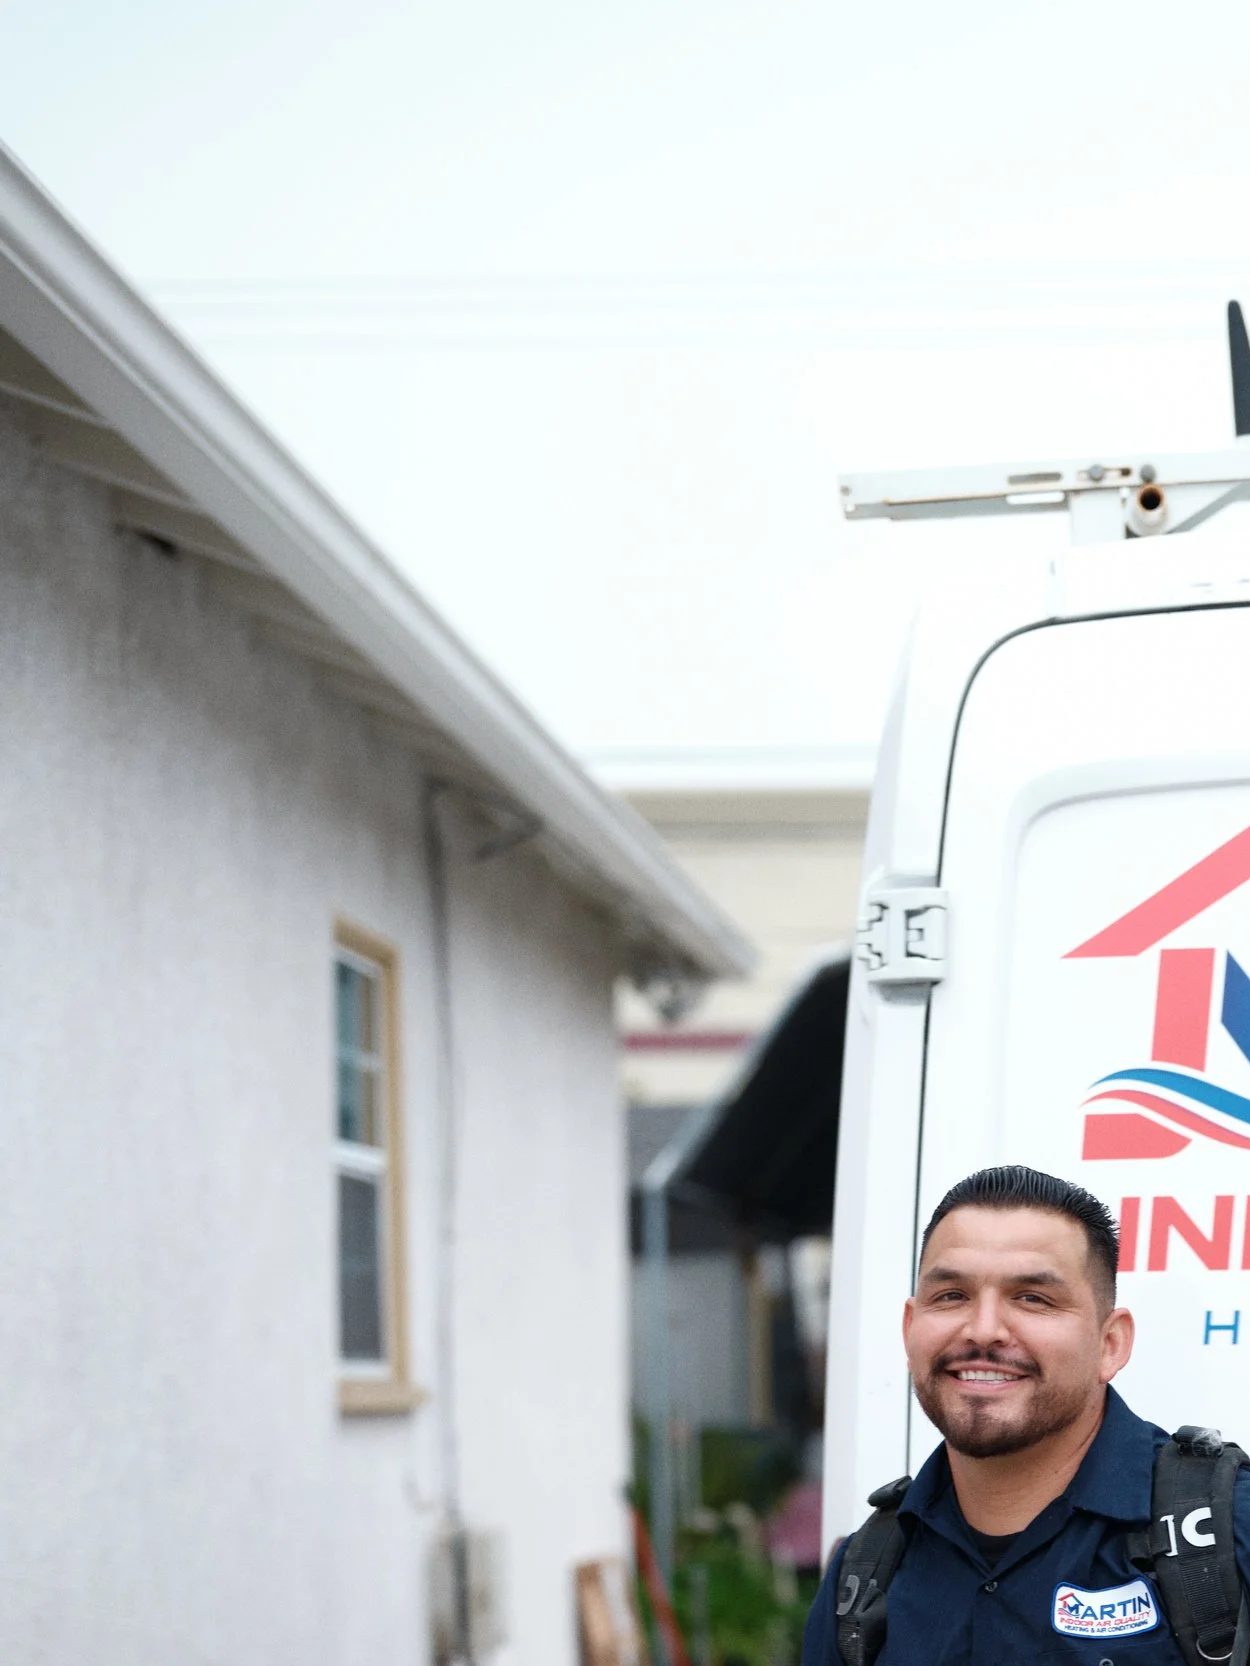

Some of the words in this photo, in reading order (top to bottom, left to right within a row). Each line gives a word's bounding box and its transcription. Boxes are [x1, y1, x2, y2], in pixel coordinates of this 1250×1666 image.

[1060, 1592, 1151, 1620] MARTIN
[1060, 1616, 1094, 1627] INDOOR
[1096, 1619, 1112, 1627] AIR
[1114, 1611, 1151, 1626] QUALITY
[1065, 1625, 1089, 1633] HEATING
